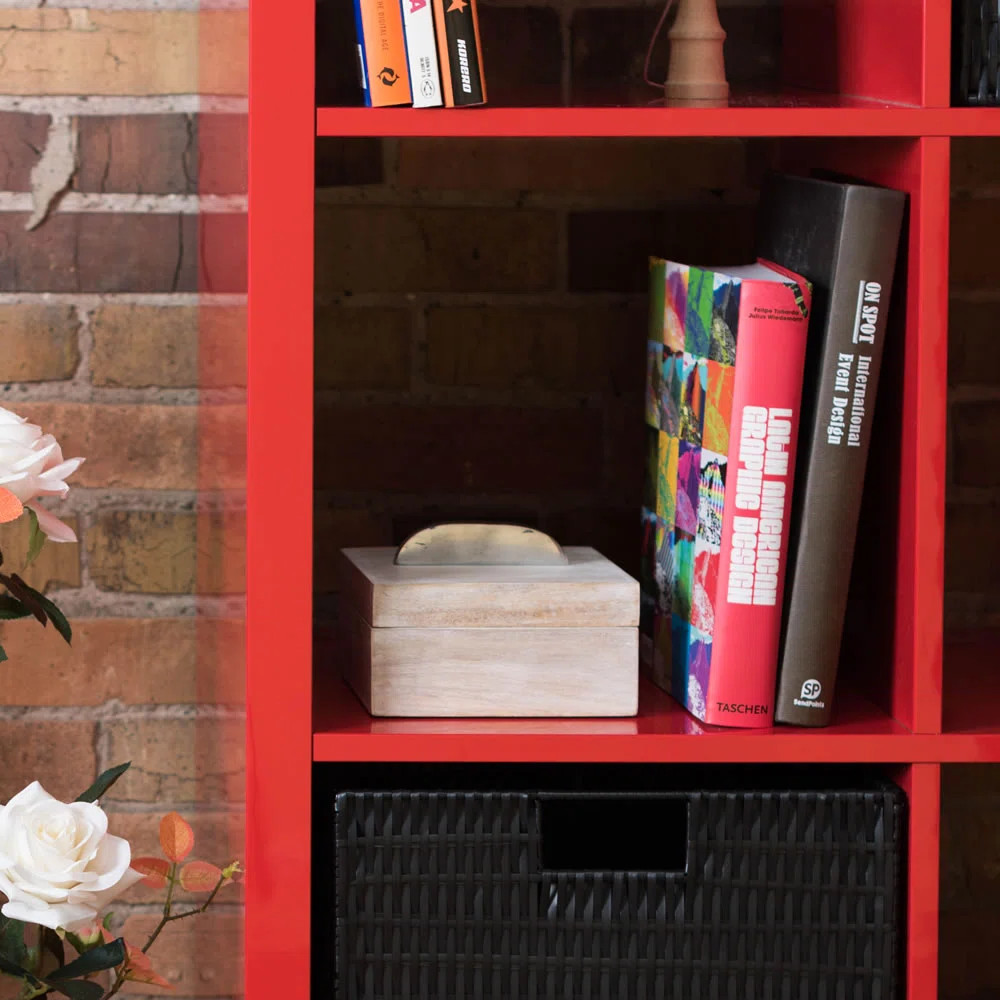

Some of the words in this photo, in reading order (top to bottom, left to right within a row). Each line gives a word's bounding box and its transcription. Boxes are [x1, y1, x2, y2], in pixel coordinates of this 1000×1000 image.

[863, 281, 882, 303] ON
[859, 305, 879, 344] SPOT
[834, 352, 854, 392] Event
[847, 354, 872, 447] International
[826, 396, 849, 445] Design
[735, 405, 768, 510] GRAPHIC
[716, 702, 768, 714] TASCHEN
[803, 682, 820, 696] SP
